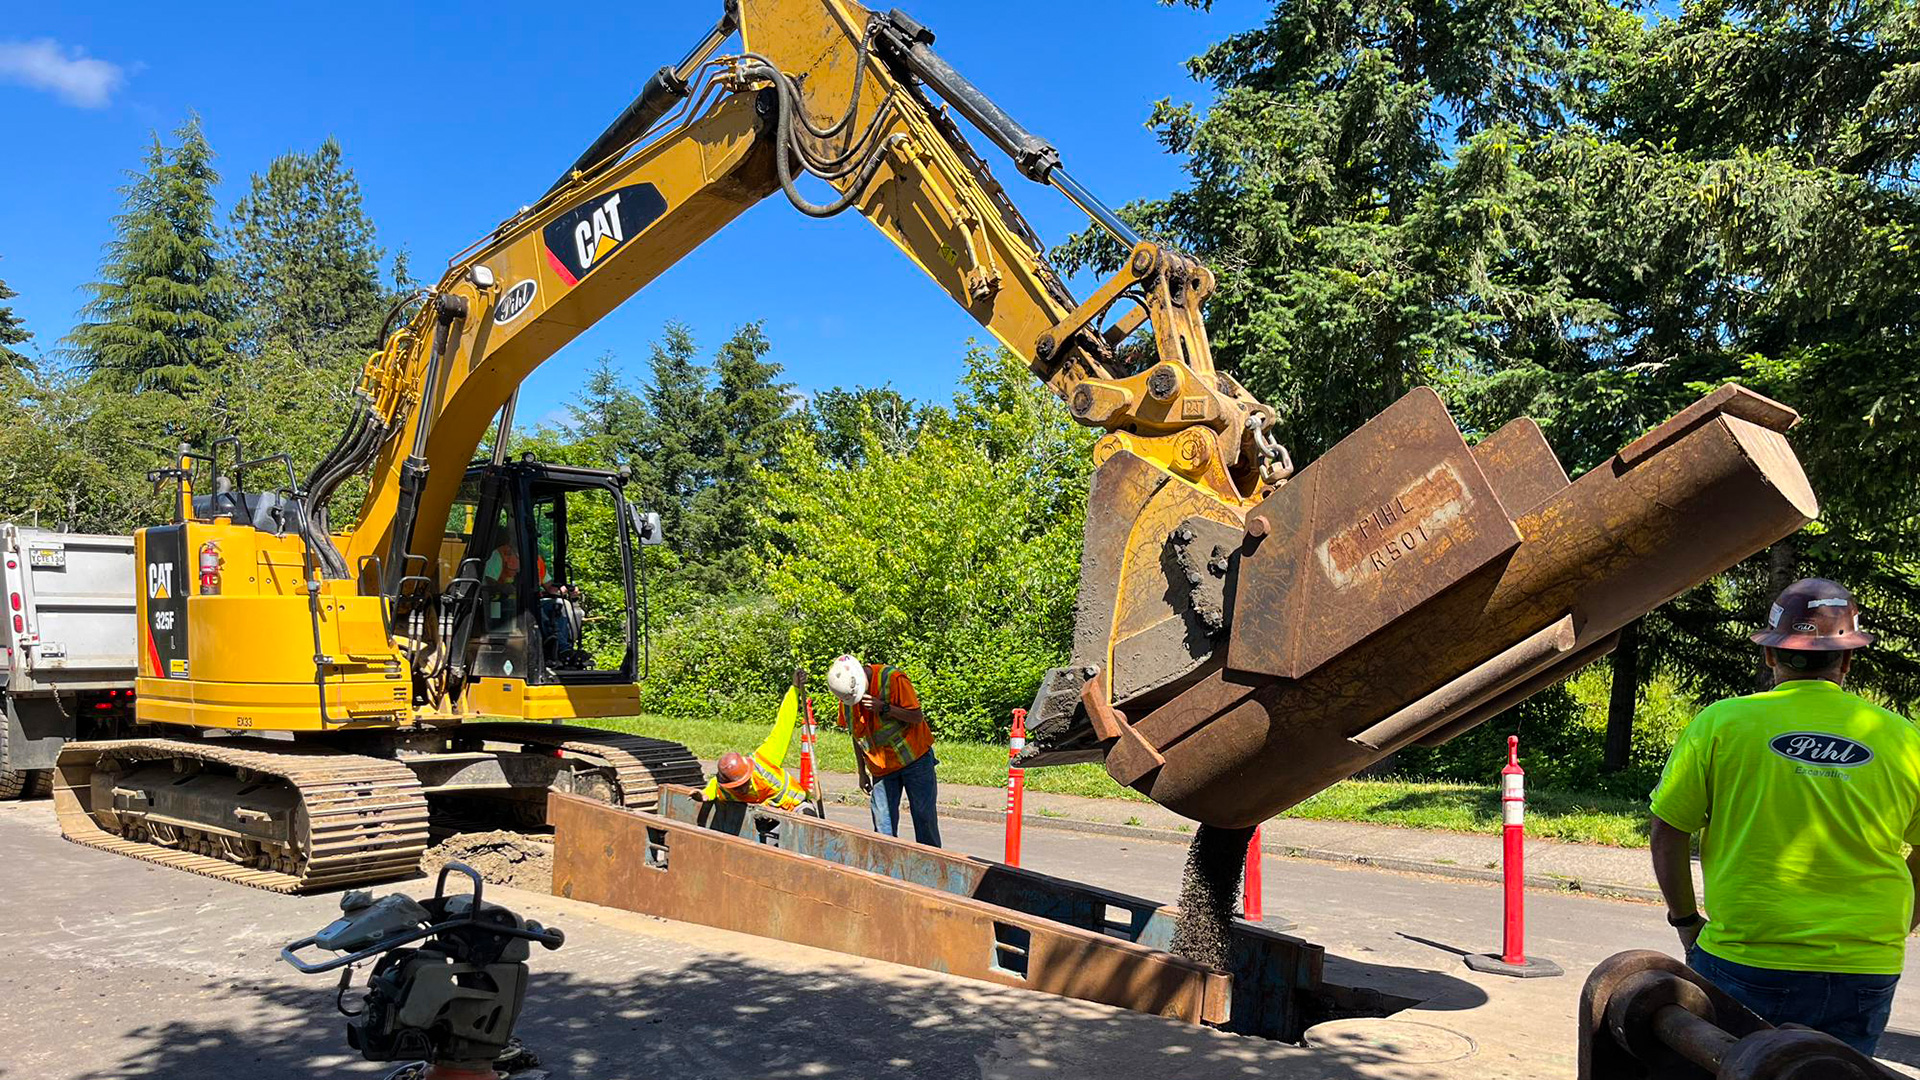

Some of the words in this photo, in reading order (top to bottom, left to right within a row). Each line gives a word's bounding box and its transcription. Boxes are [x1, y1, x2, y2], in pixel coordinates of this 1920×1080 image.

[575, 192, 624, 269] CAT
[500, 283, 530, 320] Pihl
[1358, 496, 1414, 539] PIHL
[149, 563, 173, 599] CAT
[155, 611, 175, 630] 325F
[237, 716, 252, 727] EX33
[1786, 736, 1856, 763] Pihl
[1795, 766, 1851, 781] Excavating
